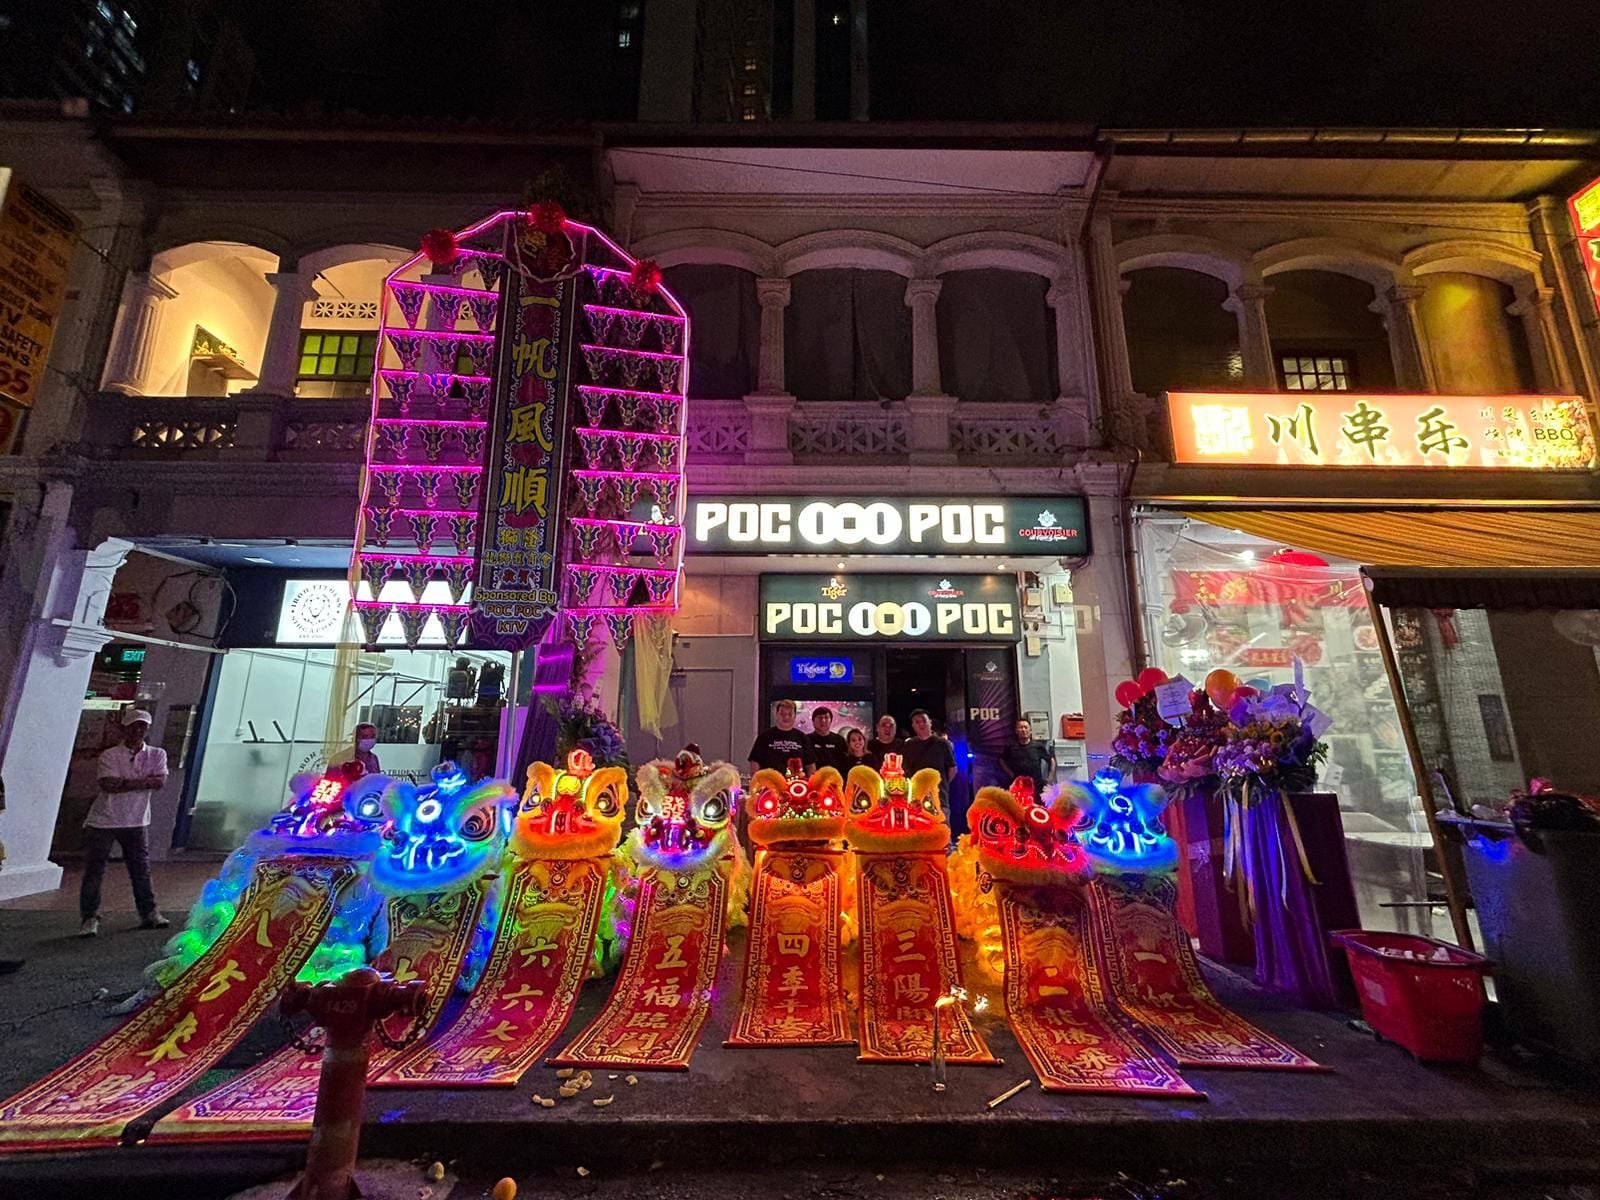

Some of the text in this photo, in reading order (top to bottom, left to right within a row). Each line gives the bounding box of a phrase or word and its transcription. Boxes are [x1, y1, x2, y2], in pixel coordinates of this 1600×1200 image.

[502, 294, 559, 517] 一帆風順
[1265, 402, 1469, 458] 川串乐
[1534, 428, 1575, 441] BBQ
[696, 503, 1006, 544] POC POC
[1018, 529, 1077, 537] COURVOISIER
[476, 589, 556, 605] Sponsored By
[822, 586, 848, 600] Tiger
[484, 605, 543, 617] POC POC
[766, 602, 1014, 635] POC POC
[497, 621, 527, 632] KTV
[970, 707, 1000, 721] POC
[611, 935, 688, 1050] 五福臨門
[768, 932, 814, 1037] 四季平安
